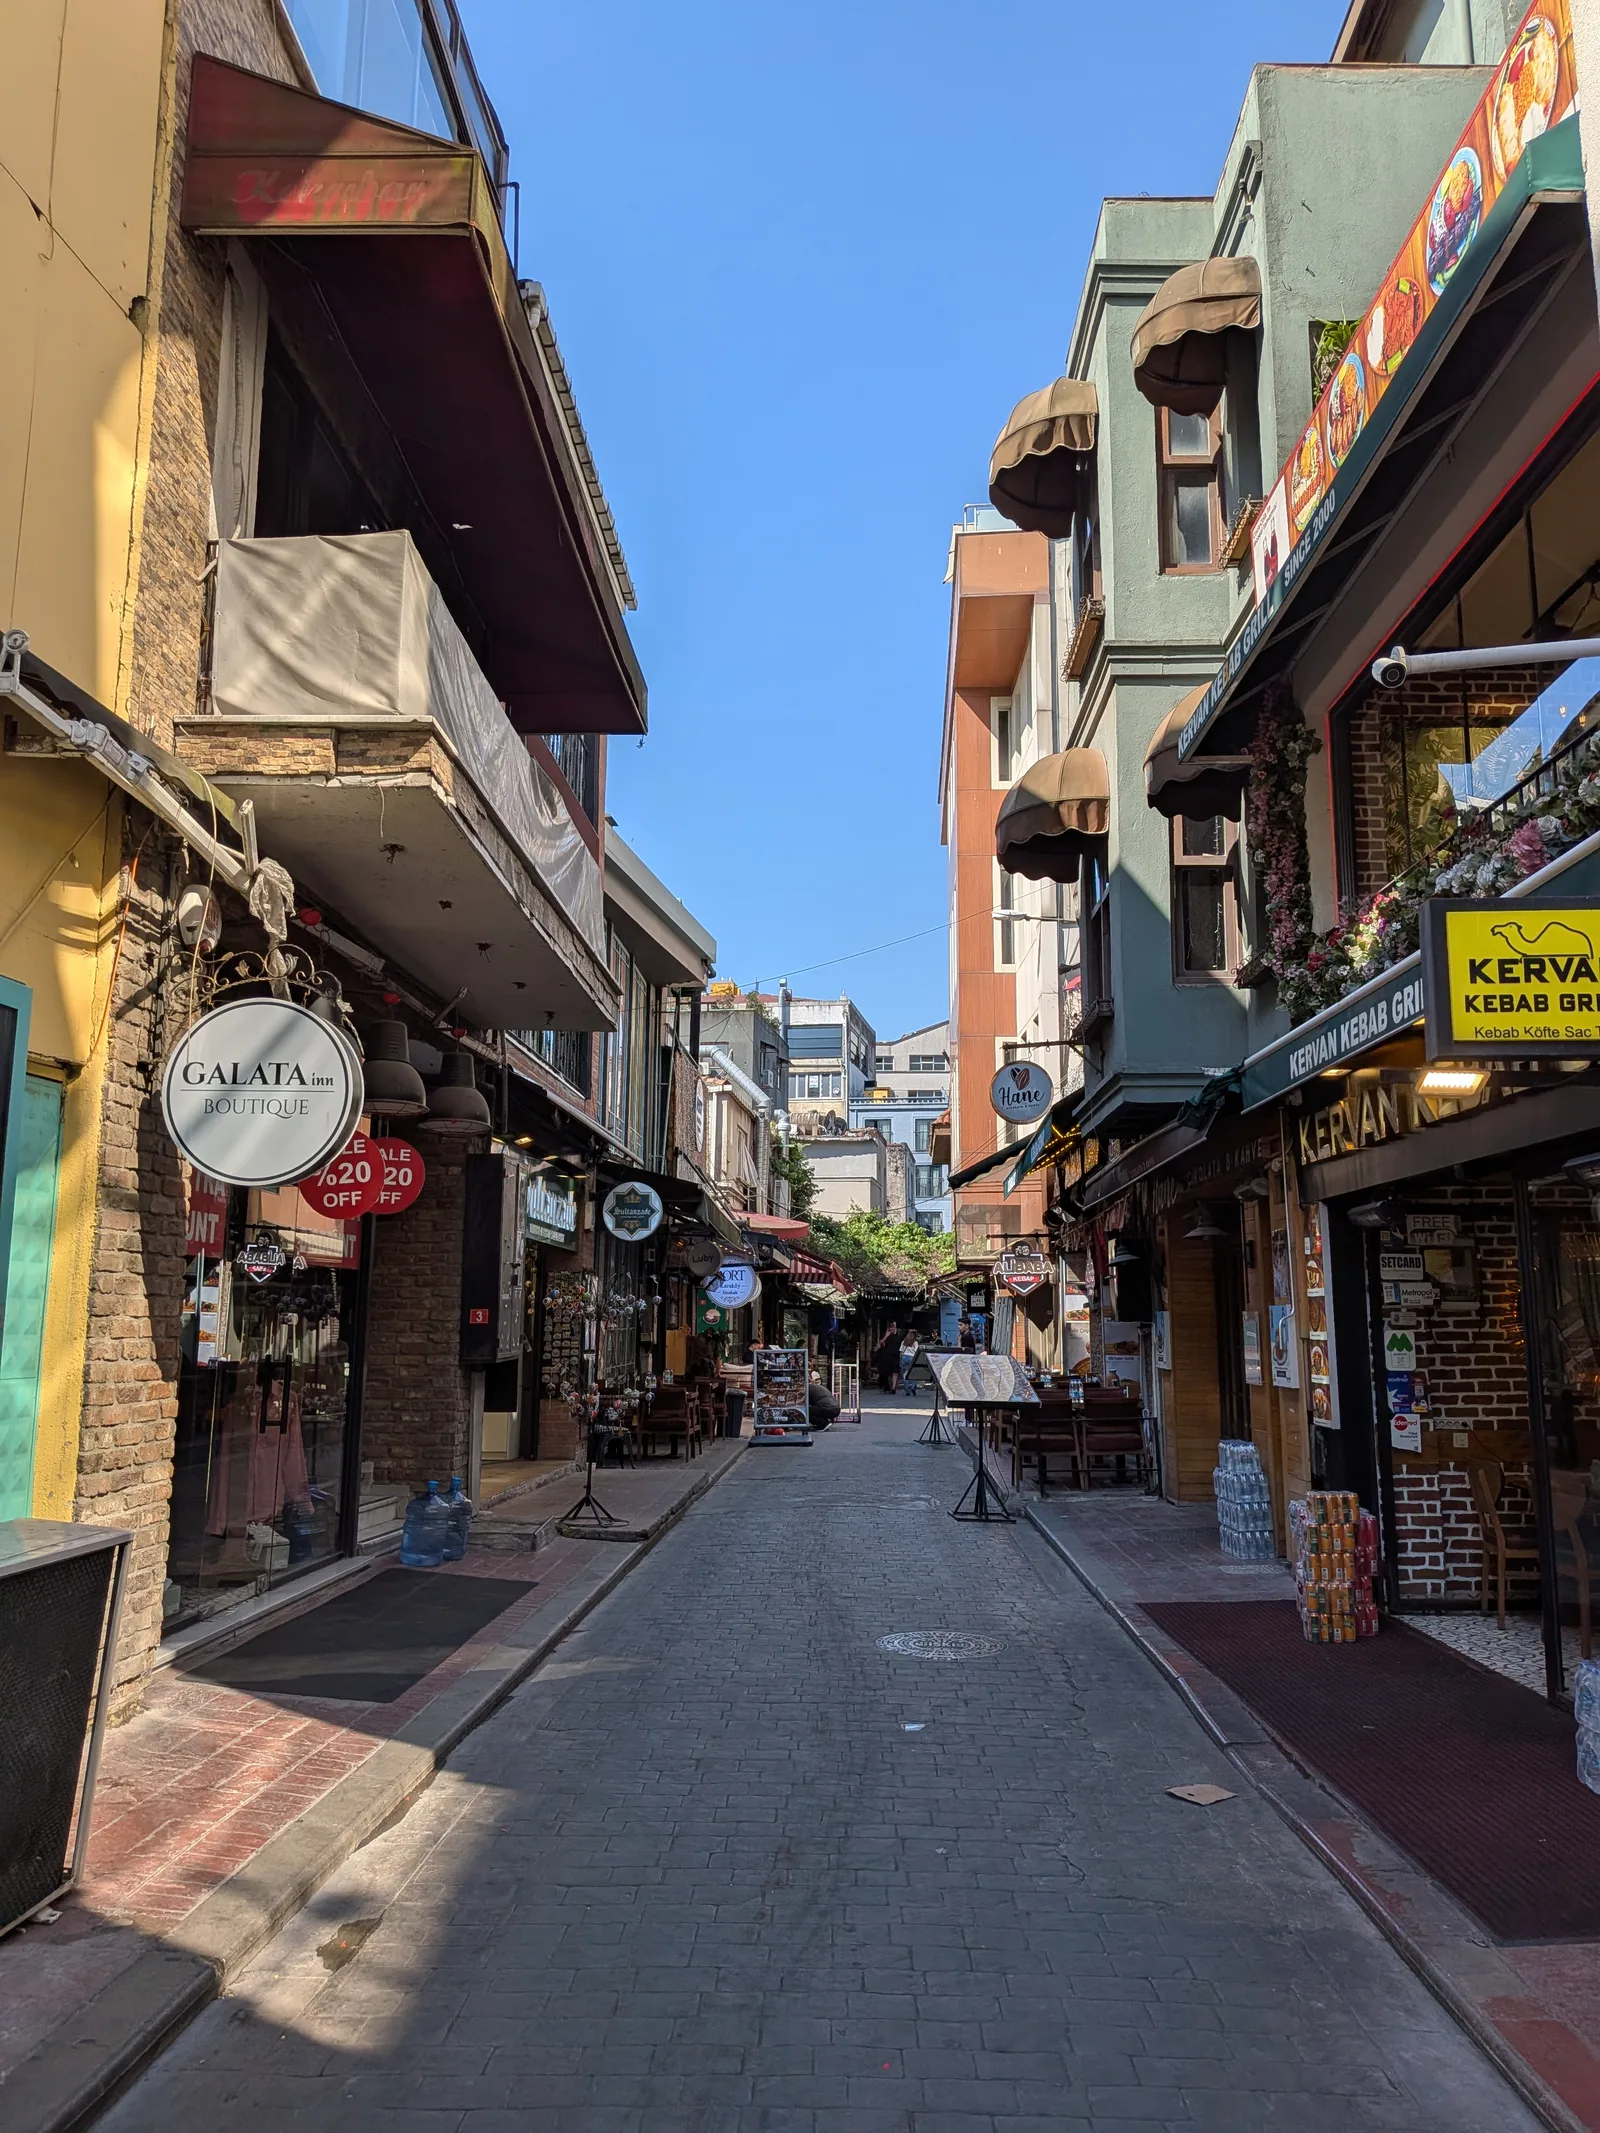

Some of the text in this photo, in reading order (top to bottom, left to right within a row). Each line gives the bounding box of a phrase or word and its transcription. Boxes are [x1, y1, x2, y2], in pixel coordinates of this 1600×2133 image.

[1284, 488, 1336, 587] SINCE 2000
[1178, 592, 1273, 759] KERVAN KEBAB GRILL
[1468, 957, 1600, 984] KERVA
[1465, 993, 1549, 1013] KEBAB
[1474, 1026, 1520, 1039] Kebab
[1524, 1025, 1560, 1039] Köfte
[1565, 1026, 1592, 1039] Sac
[1289, 1029, 1338, 1080] KERVAN
[1340, 1001, 1388, 1053] KEBAB
[182, 1061, 334, 1086] GALATA inn
[998, 1087, 1046, 1107] Hane
[204, 1098, 309, 1119] BOUTIQUE
[1299, 1087, 1399, 1166] KERVAN
[379, 1148, 411, 1162] ALE
[323, 1190, 362, 1208] OFF
[379, 1191, 402, 1205] FF
[1413, 1216, 1451, 1228] FREE
[692, 1254, 714, 1264] Luby
[1382, 1256, 1421, 1268] SETCARD
[722, 1269, 747, 1282] ORT
[1012, 1275, 1035, 1283] KEBAP
[1401, 1288, 1433, 1299] Metropol
[475, 1311, 483, 1322] 3
